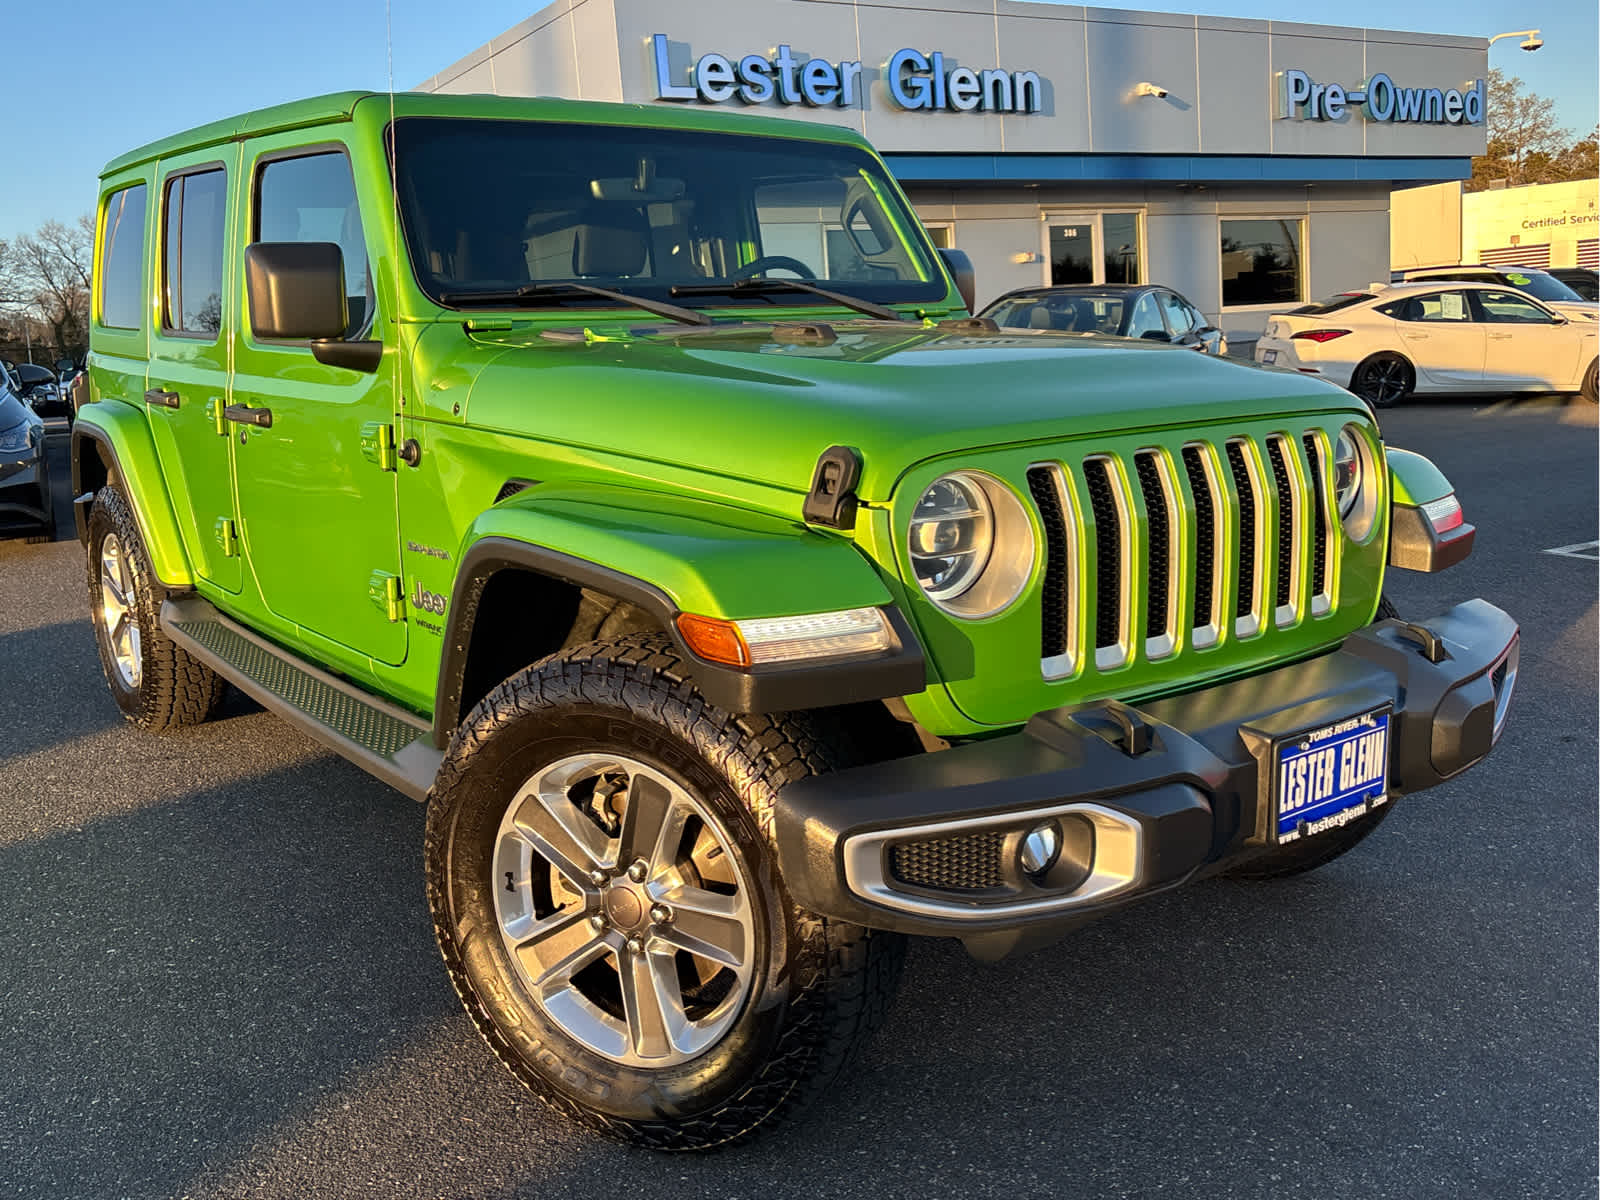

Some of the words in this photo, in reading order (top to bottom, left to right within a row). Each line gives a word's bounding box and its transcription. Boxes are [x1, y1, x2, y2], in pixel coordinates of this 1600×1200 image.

[651, 33, 863, 108] Lester
[885, 47, 1042, 114] Glenn
[1285, 69, 1485, 123] Pre-Owned
[1521, 215, 1566, 230] Certified
[1570, 212, 1600, 225] Servic
[1279, 747, 1336, 815] LESTER
[1340, 729, 1385, 791] GLENN
[1306, 803, 1367, 837] lesterglenn
